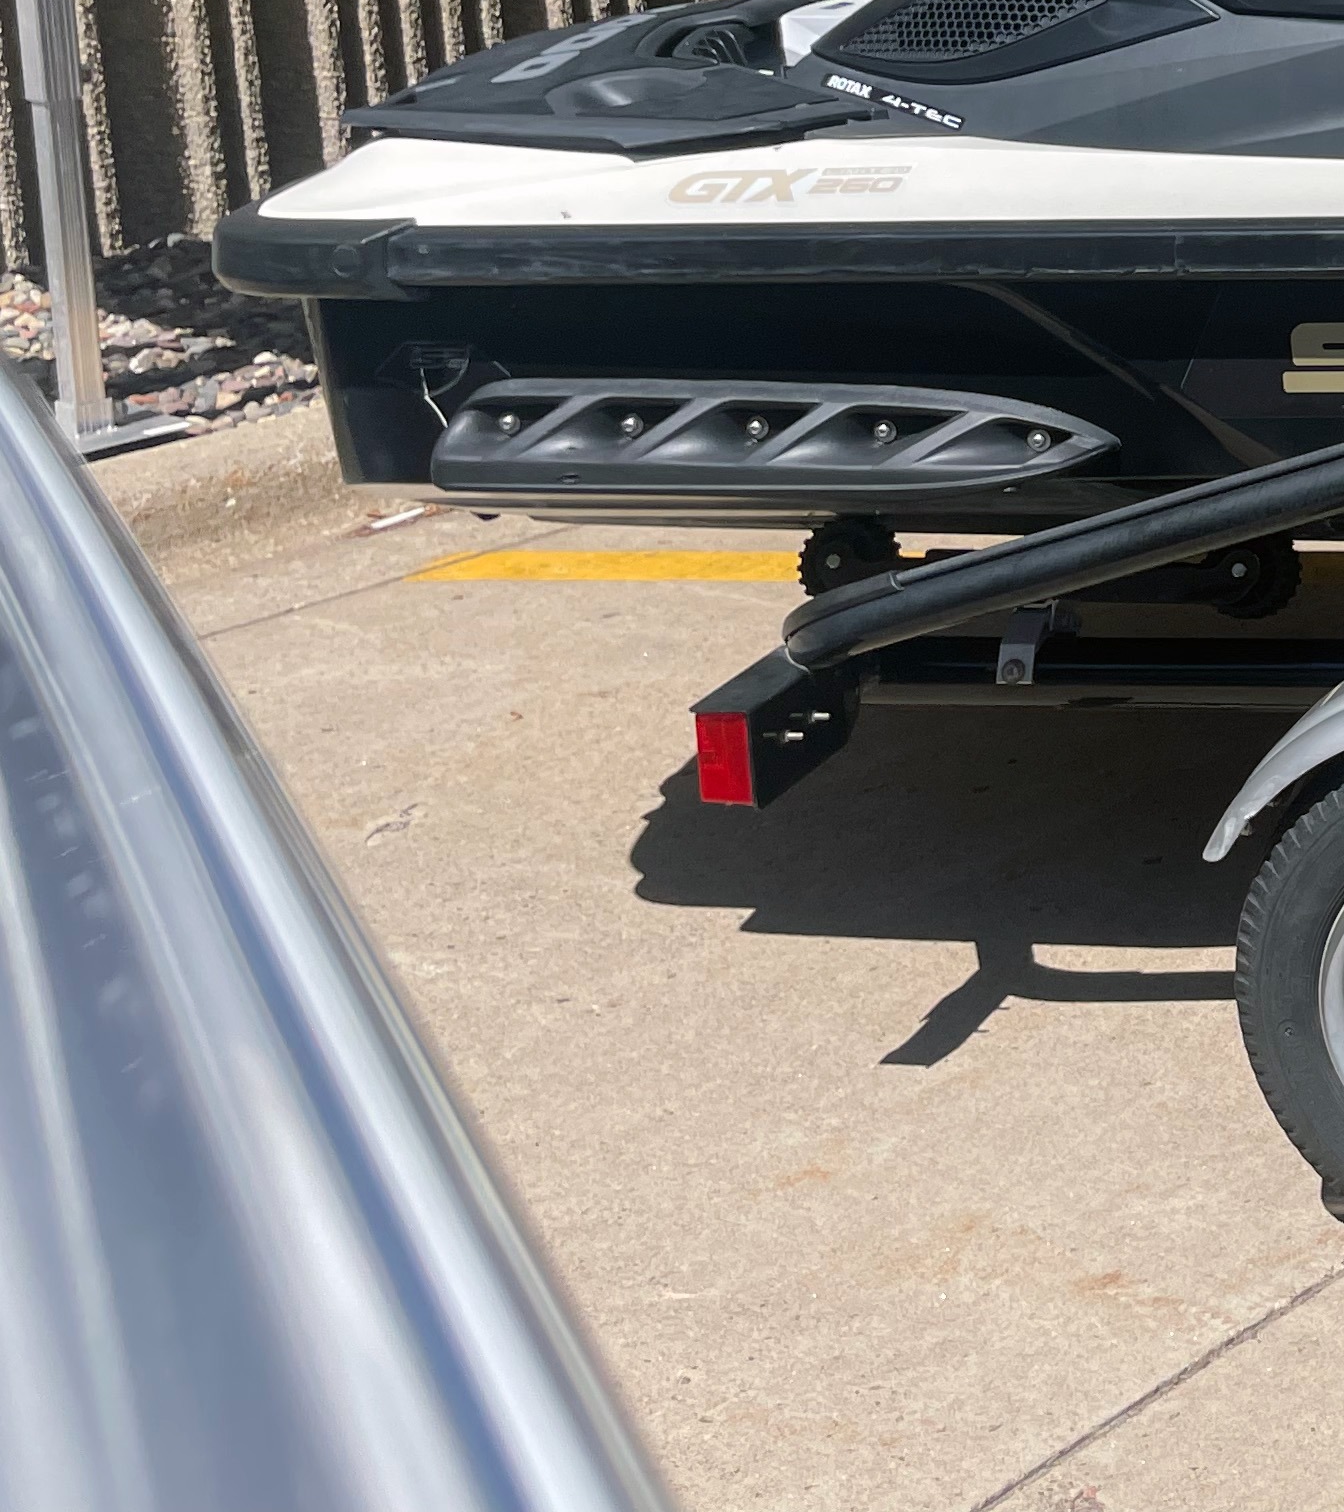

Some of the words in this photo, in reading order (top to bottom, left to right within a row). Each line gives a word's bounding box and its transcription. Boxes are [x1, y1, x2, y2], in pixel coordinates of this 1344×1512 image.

[827, 74, 873, 99] ROTAX
[881, 94, 963, 129] 4-TEC
[668, 168, 818, 204] GTX
[807, 176, 904, 195] 260
